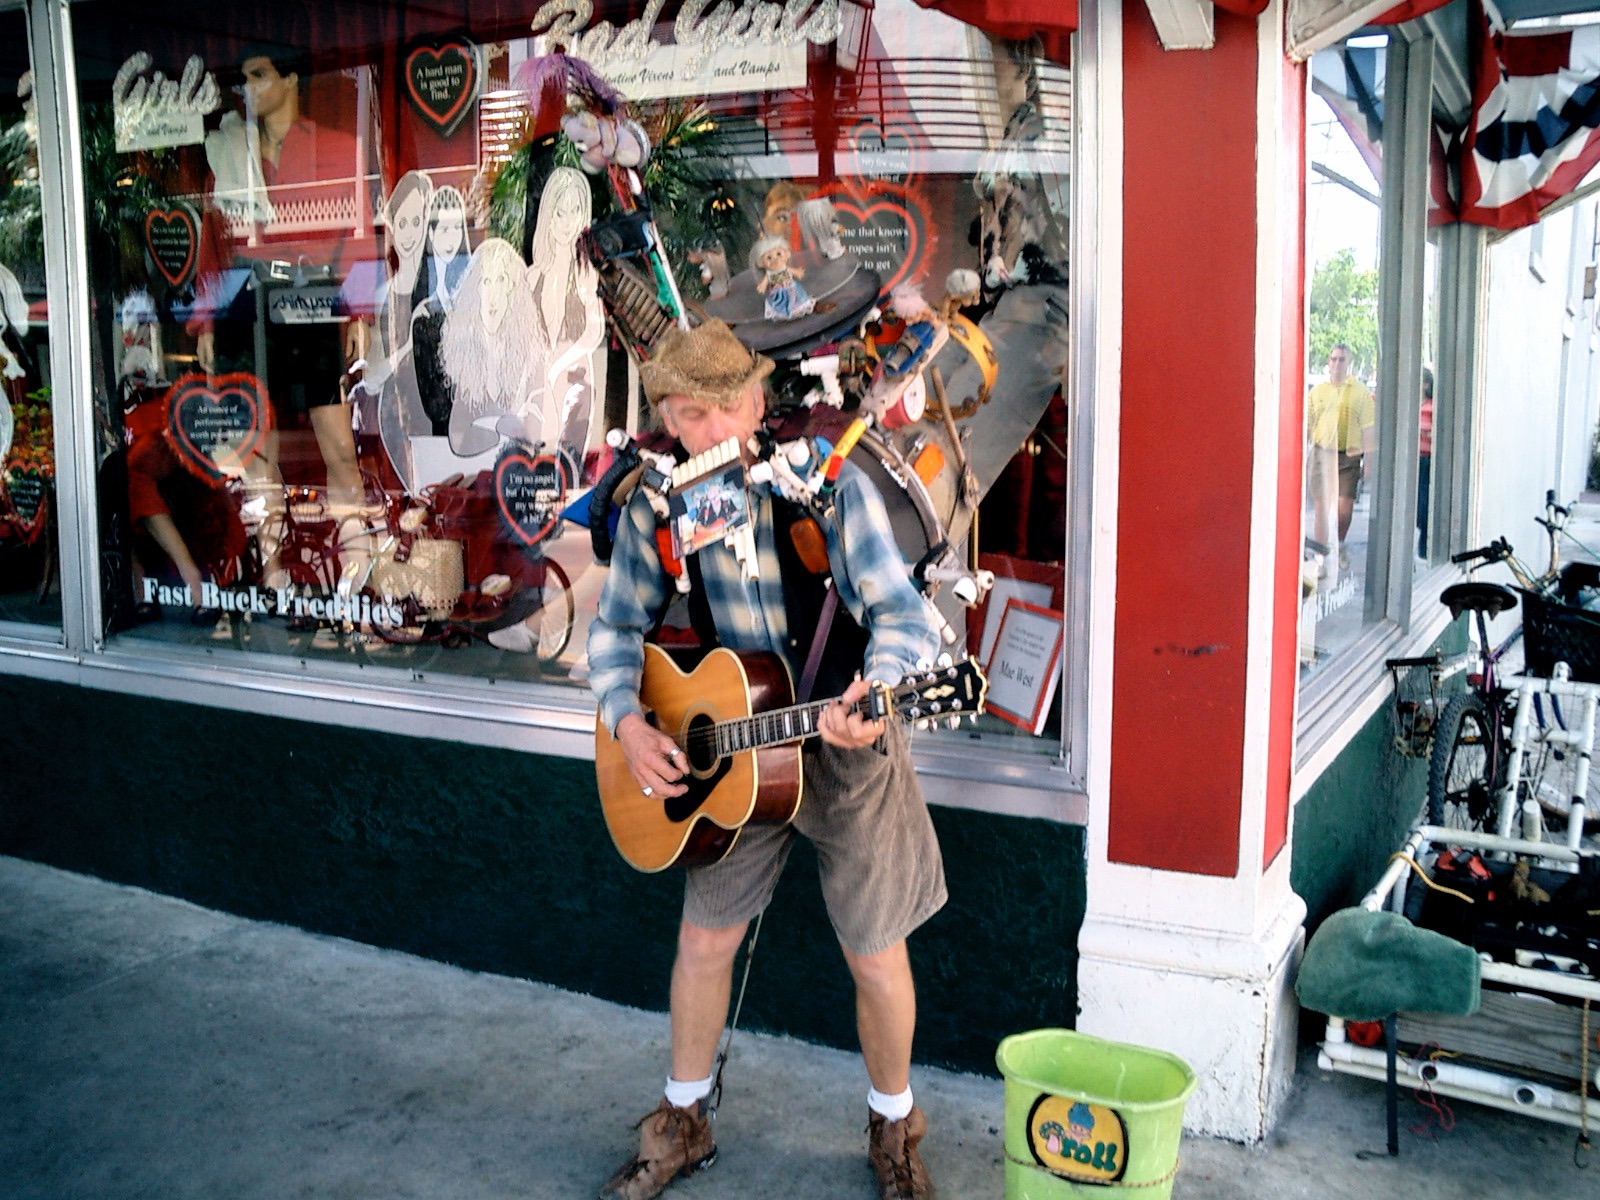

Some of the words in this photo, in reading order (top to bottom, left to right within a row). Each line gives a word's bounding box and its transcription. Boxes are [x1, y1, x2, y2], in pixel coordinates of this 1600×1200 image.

[674, 0, 844, 82] Girls
[417, 67, 424, 80] A
[425, 65, 443, 78] hard
[445, 64, 463, 75] man
[639, 68, 674, 84] Vixens
[714, 63, 737, 77] and
[738, 60, 780, 77] Vamps
[112, 50, 222, 116] Girls
[420, 80, 428, 90] is
[429, 75, 449, 91] good
[451, 76, 460, 87] to
[431, 87, 451, 101] find.
[842, 228, 856, 237] me
[858, 226, 876, 237] that
[878, 226, 909, 237] knows
[848, 245, 874, 256] ropes
[876, 242, 897, 253] isn't
[864, 260, 874, 270] to
[876, 260, 891, 272] get
[509, 473, 523, 485] I'm
[523, 475, 534, 485] no
[505, 486, 517, 498] but
[521, 486, 535, 498] I've
[515, 501, 526, 513] my
[523, 514, 528, 524] a
[142, 577, 194, 607] Fast
[200, 581, 269, 614] Buck
[276, 584, 405, 627] Freddie's
[1000, 659, 1015, 680] Mae
[1016, 665, 1034, 688] West
